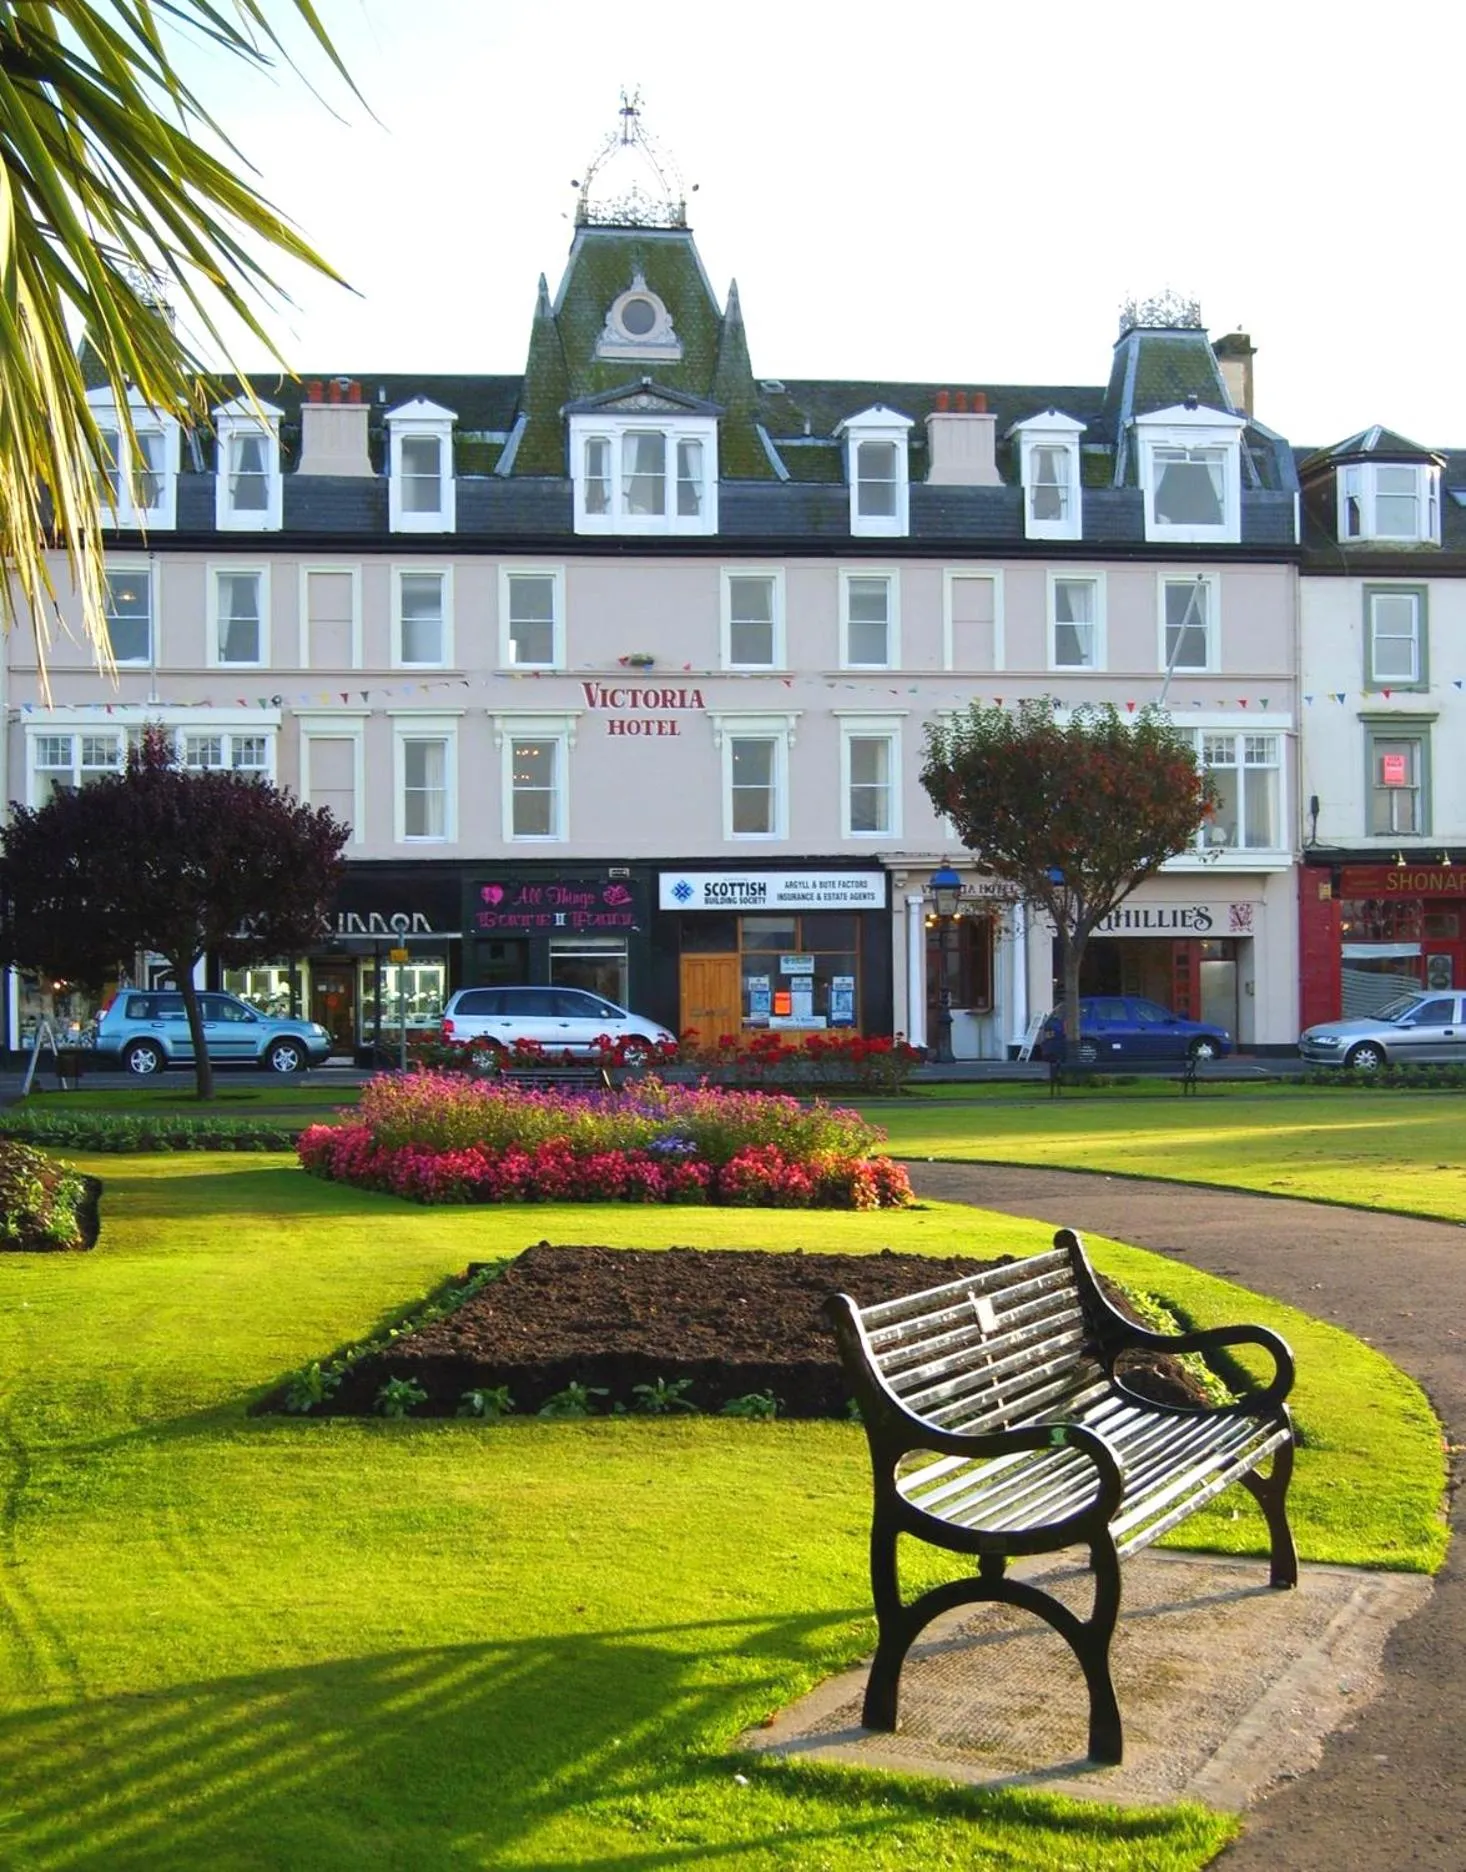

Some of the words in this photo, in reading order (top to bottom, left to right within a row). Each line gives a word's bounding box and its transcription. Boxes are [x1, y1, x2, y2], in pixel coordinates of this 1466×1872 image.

[581, 682, 706, 709] VICTORIA
[607, 719, 681, 736] HOTEL
[704, 882, 767, 897] SCOTTISH
[784, 880, 810, 889] ARGYLL
[838, 880, 868, 889] FACTORS
[704, 897, 737, 905] BUILDING
[740, 897, 766, 905] SOCIETY
[777, 892, 815, 901] INSURANCE
[824, 892, 848, 901] ESTATE
[850, 892, 876, 901] AGENTS
